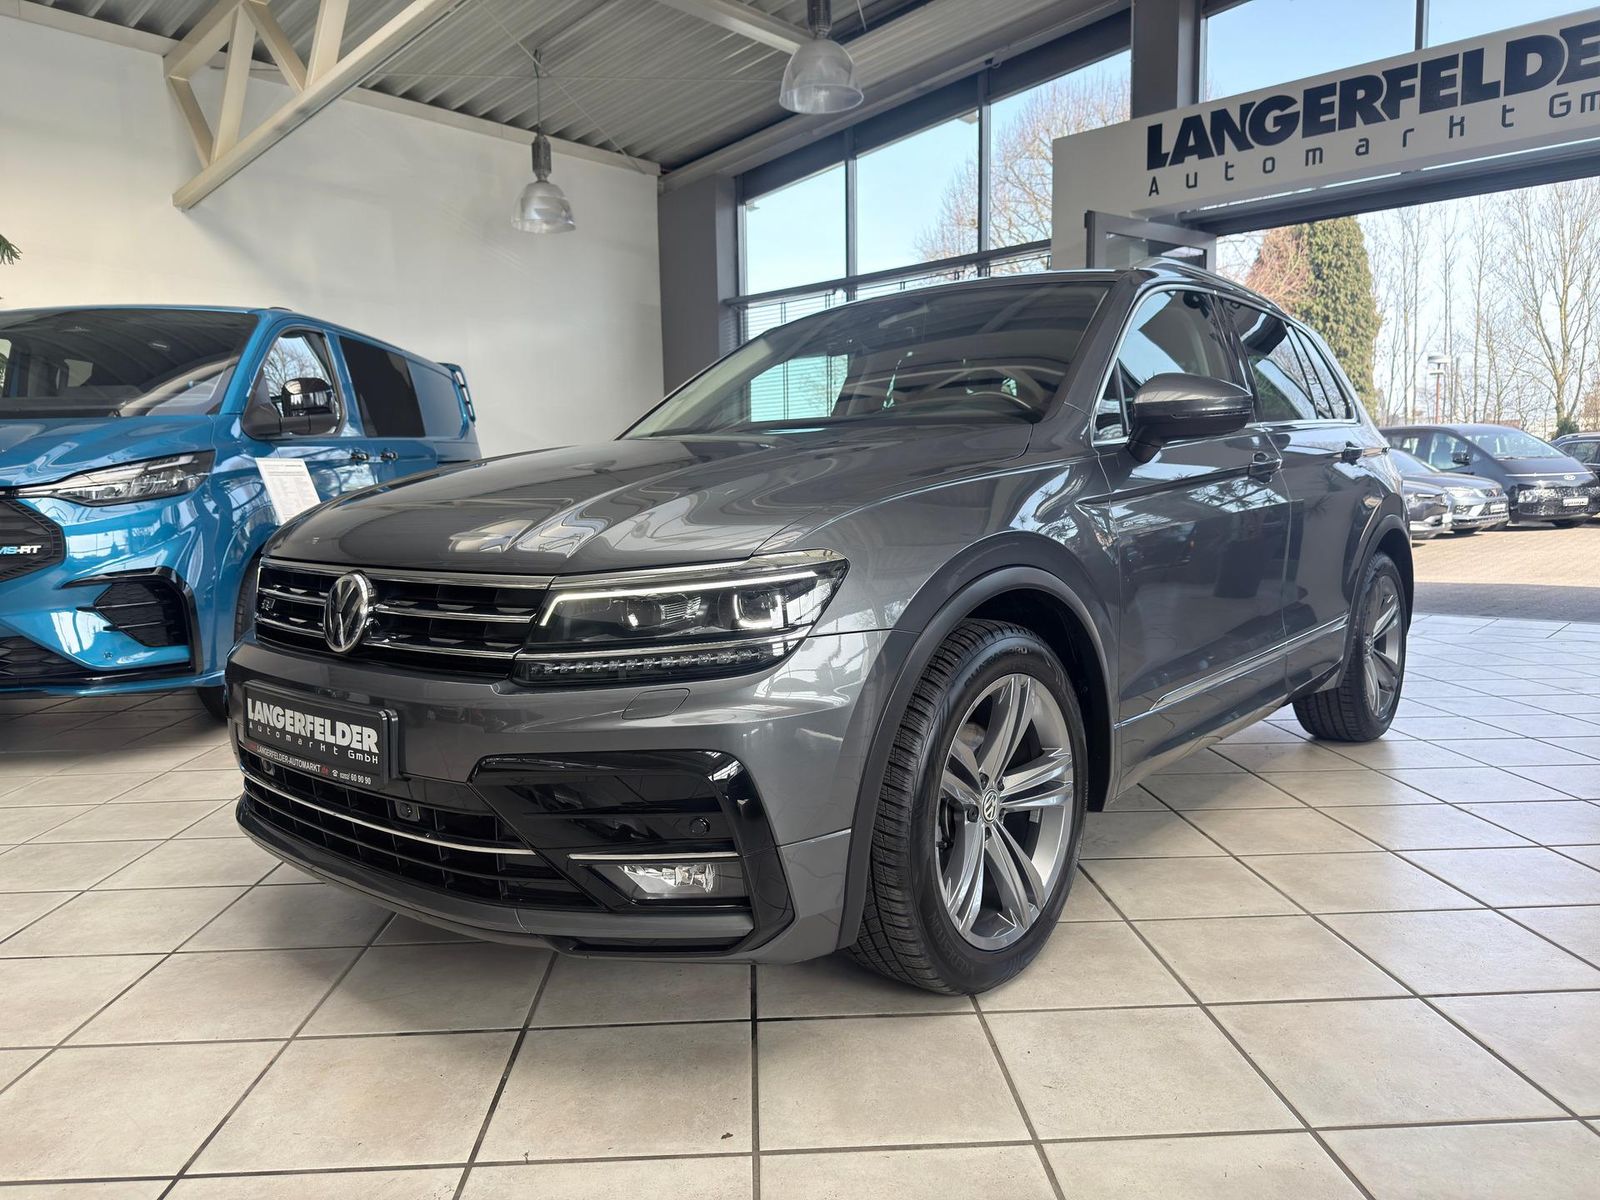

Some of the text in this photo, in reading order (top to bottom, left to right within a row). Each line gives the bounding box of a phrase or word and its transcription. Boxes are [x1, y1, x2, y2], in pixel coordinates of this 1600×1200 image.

[1149, 104, 1516, 197] Automarkt
[247, 698, 379, 754] LANGERFELDER
[347, 749, 379, 765] GmbH
